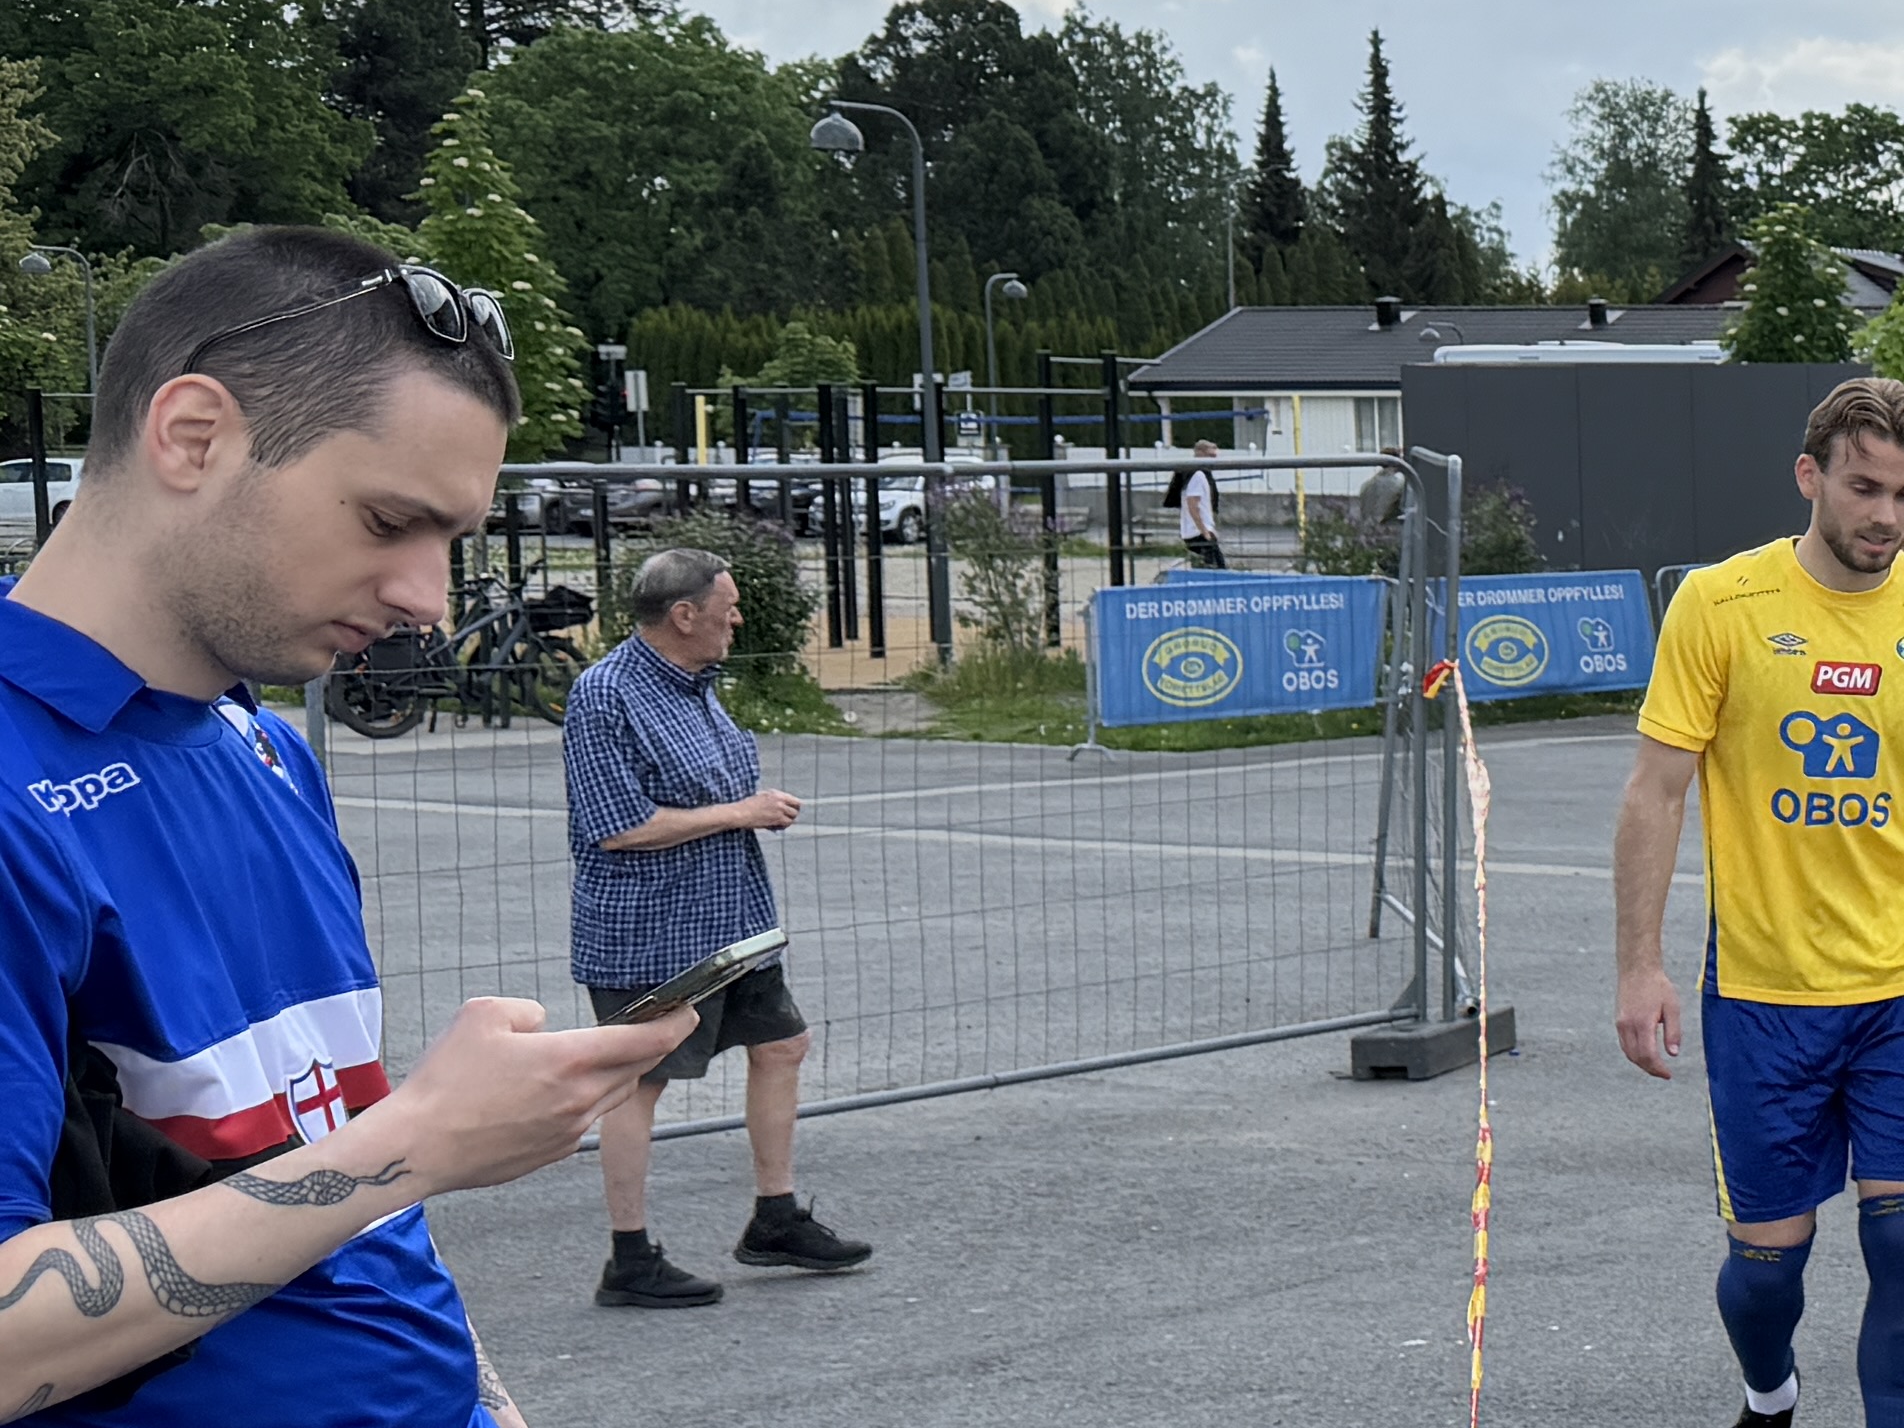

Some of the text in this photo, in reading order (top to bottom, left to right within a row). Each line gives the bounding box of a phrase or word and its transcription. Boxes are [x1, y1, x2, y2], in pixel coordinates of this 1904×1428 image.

[1125, 592, 1345, 620] DER DRØMMER OPPFYLLES!
[1580, 653, 1628, 674] OBOS
[1282, 669, 1339, 692] OBOS
[1816, 664, 1873, 690] PGM
[1770, 787, 1893, 829] OBOS
